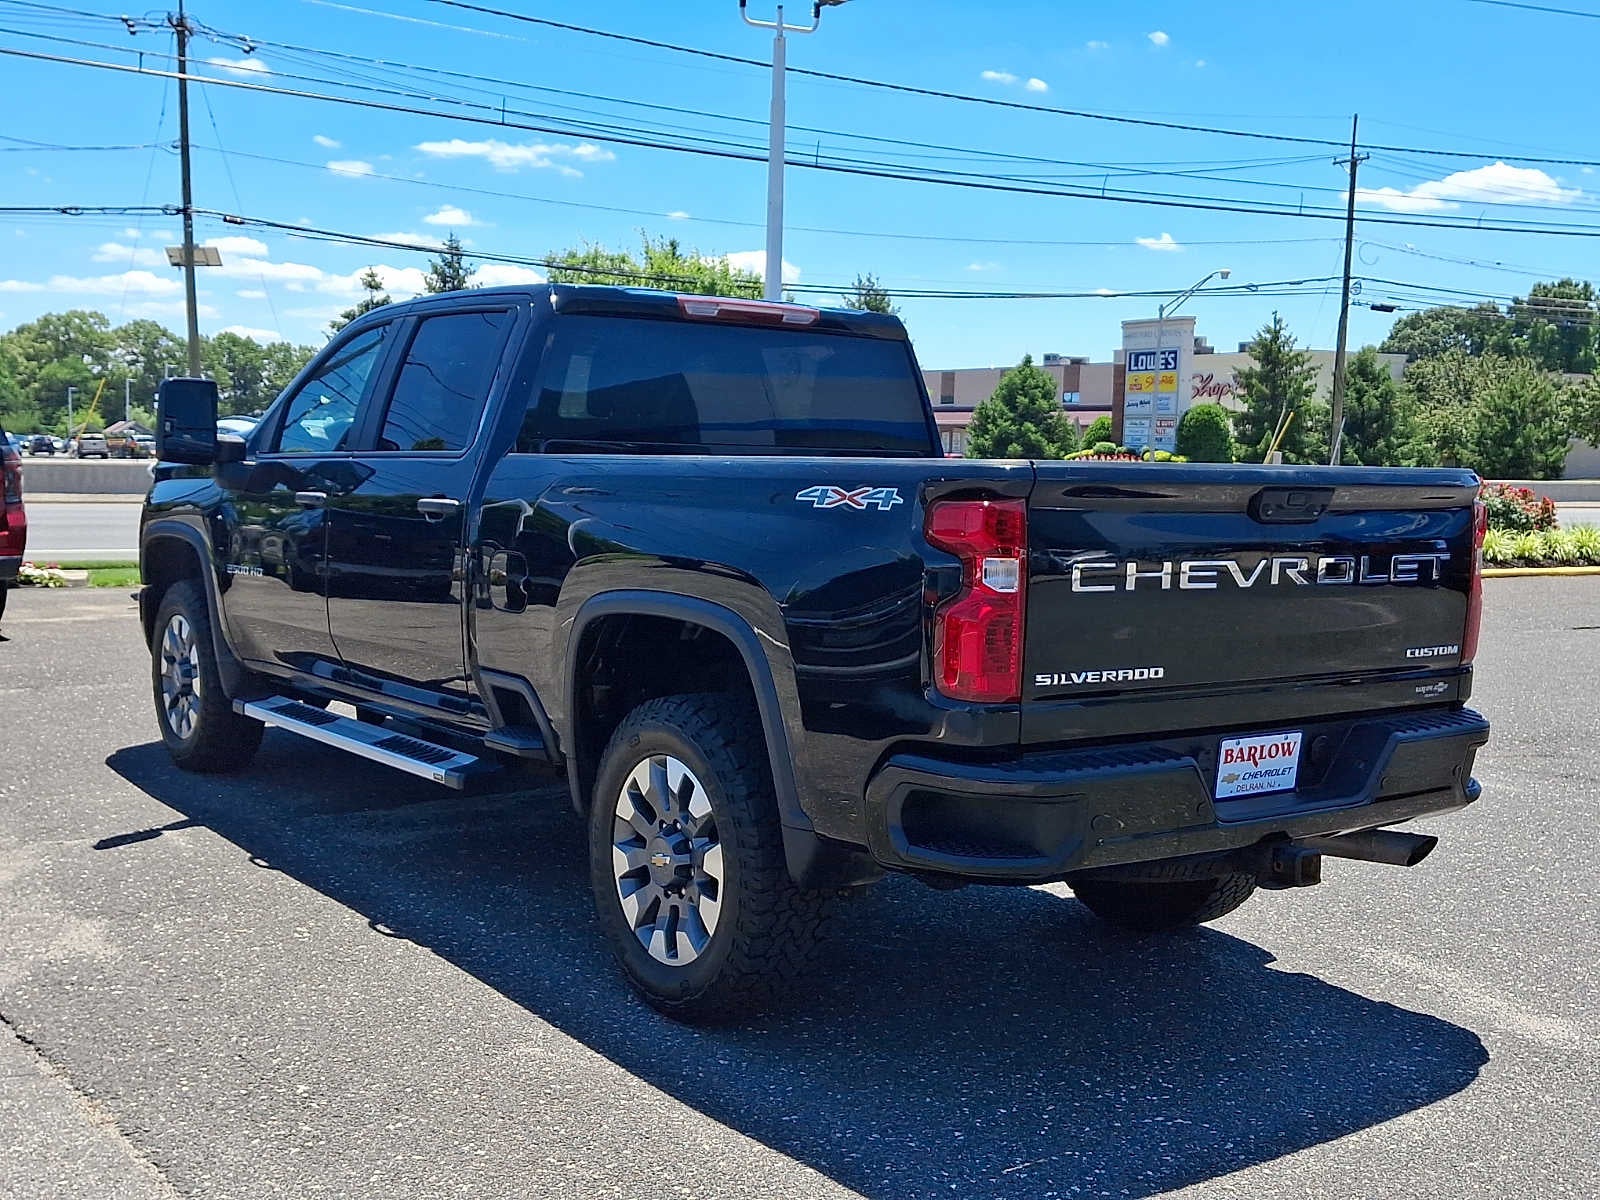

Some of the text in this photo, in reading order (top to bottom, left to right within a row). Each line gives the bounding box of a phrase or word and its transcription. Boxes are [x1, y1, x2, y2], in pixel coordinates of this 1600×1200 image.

[1130, 351, 1175, 370] LOWE'S
[1071, 553, 1450, 593] CHEVROLET
[1406, 645, 1458, 658] CUSTOM
[1035, 667, 1164, 686] SILVERADO
[1223, 741, 1297, 768] BARLOW
[1242, 766, 1294, 780] CHEVROLET
[1266, 780, 1276, 789] NJ
